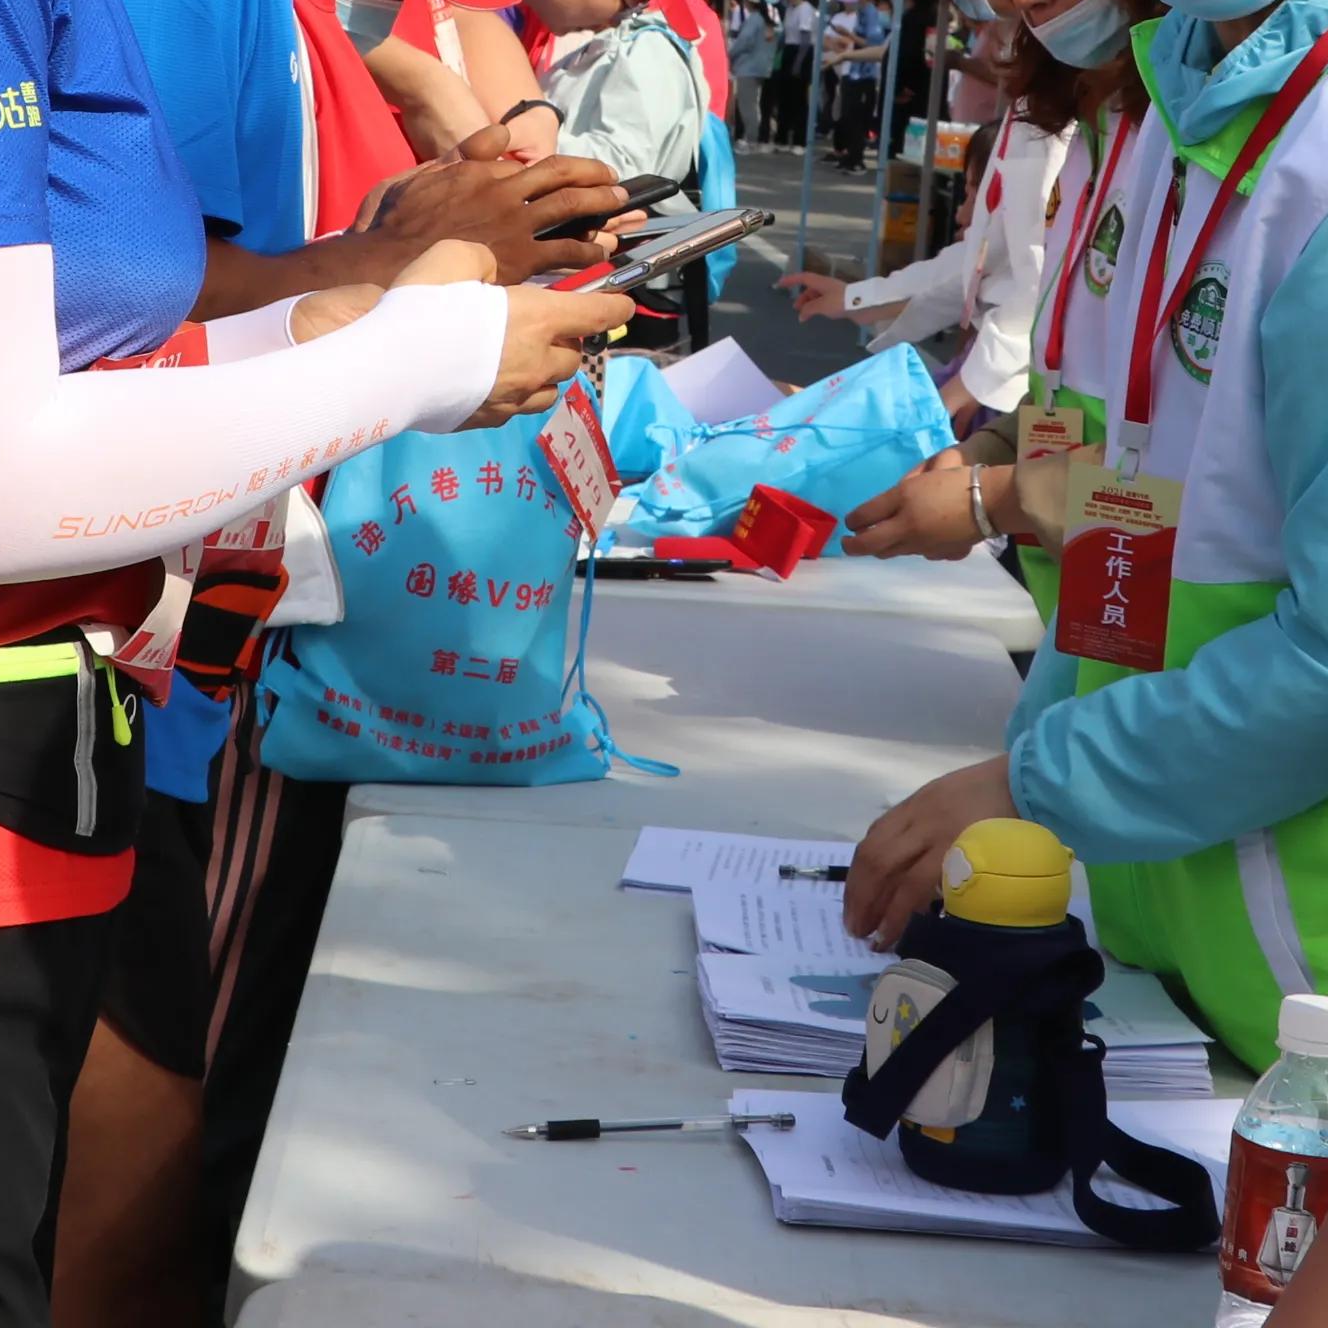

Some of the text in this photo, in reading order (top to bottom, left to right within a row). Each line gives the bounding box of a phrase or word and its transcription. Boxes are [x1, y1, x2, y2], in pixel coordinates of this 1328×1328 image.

[52, 480, 240, 540] SUNGROW
[1101, 533, 1134, 629] 工作人员
[429, 647, 520, 685] 第二届
